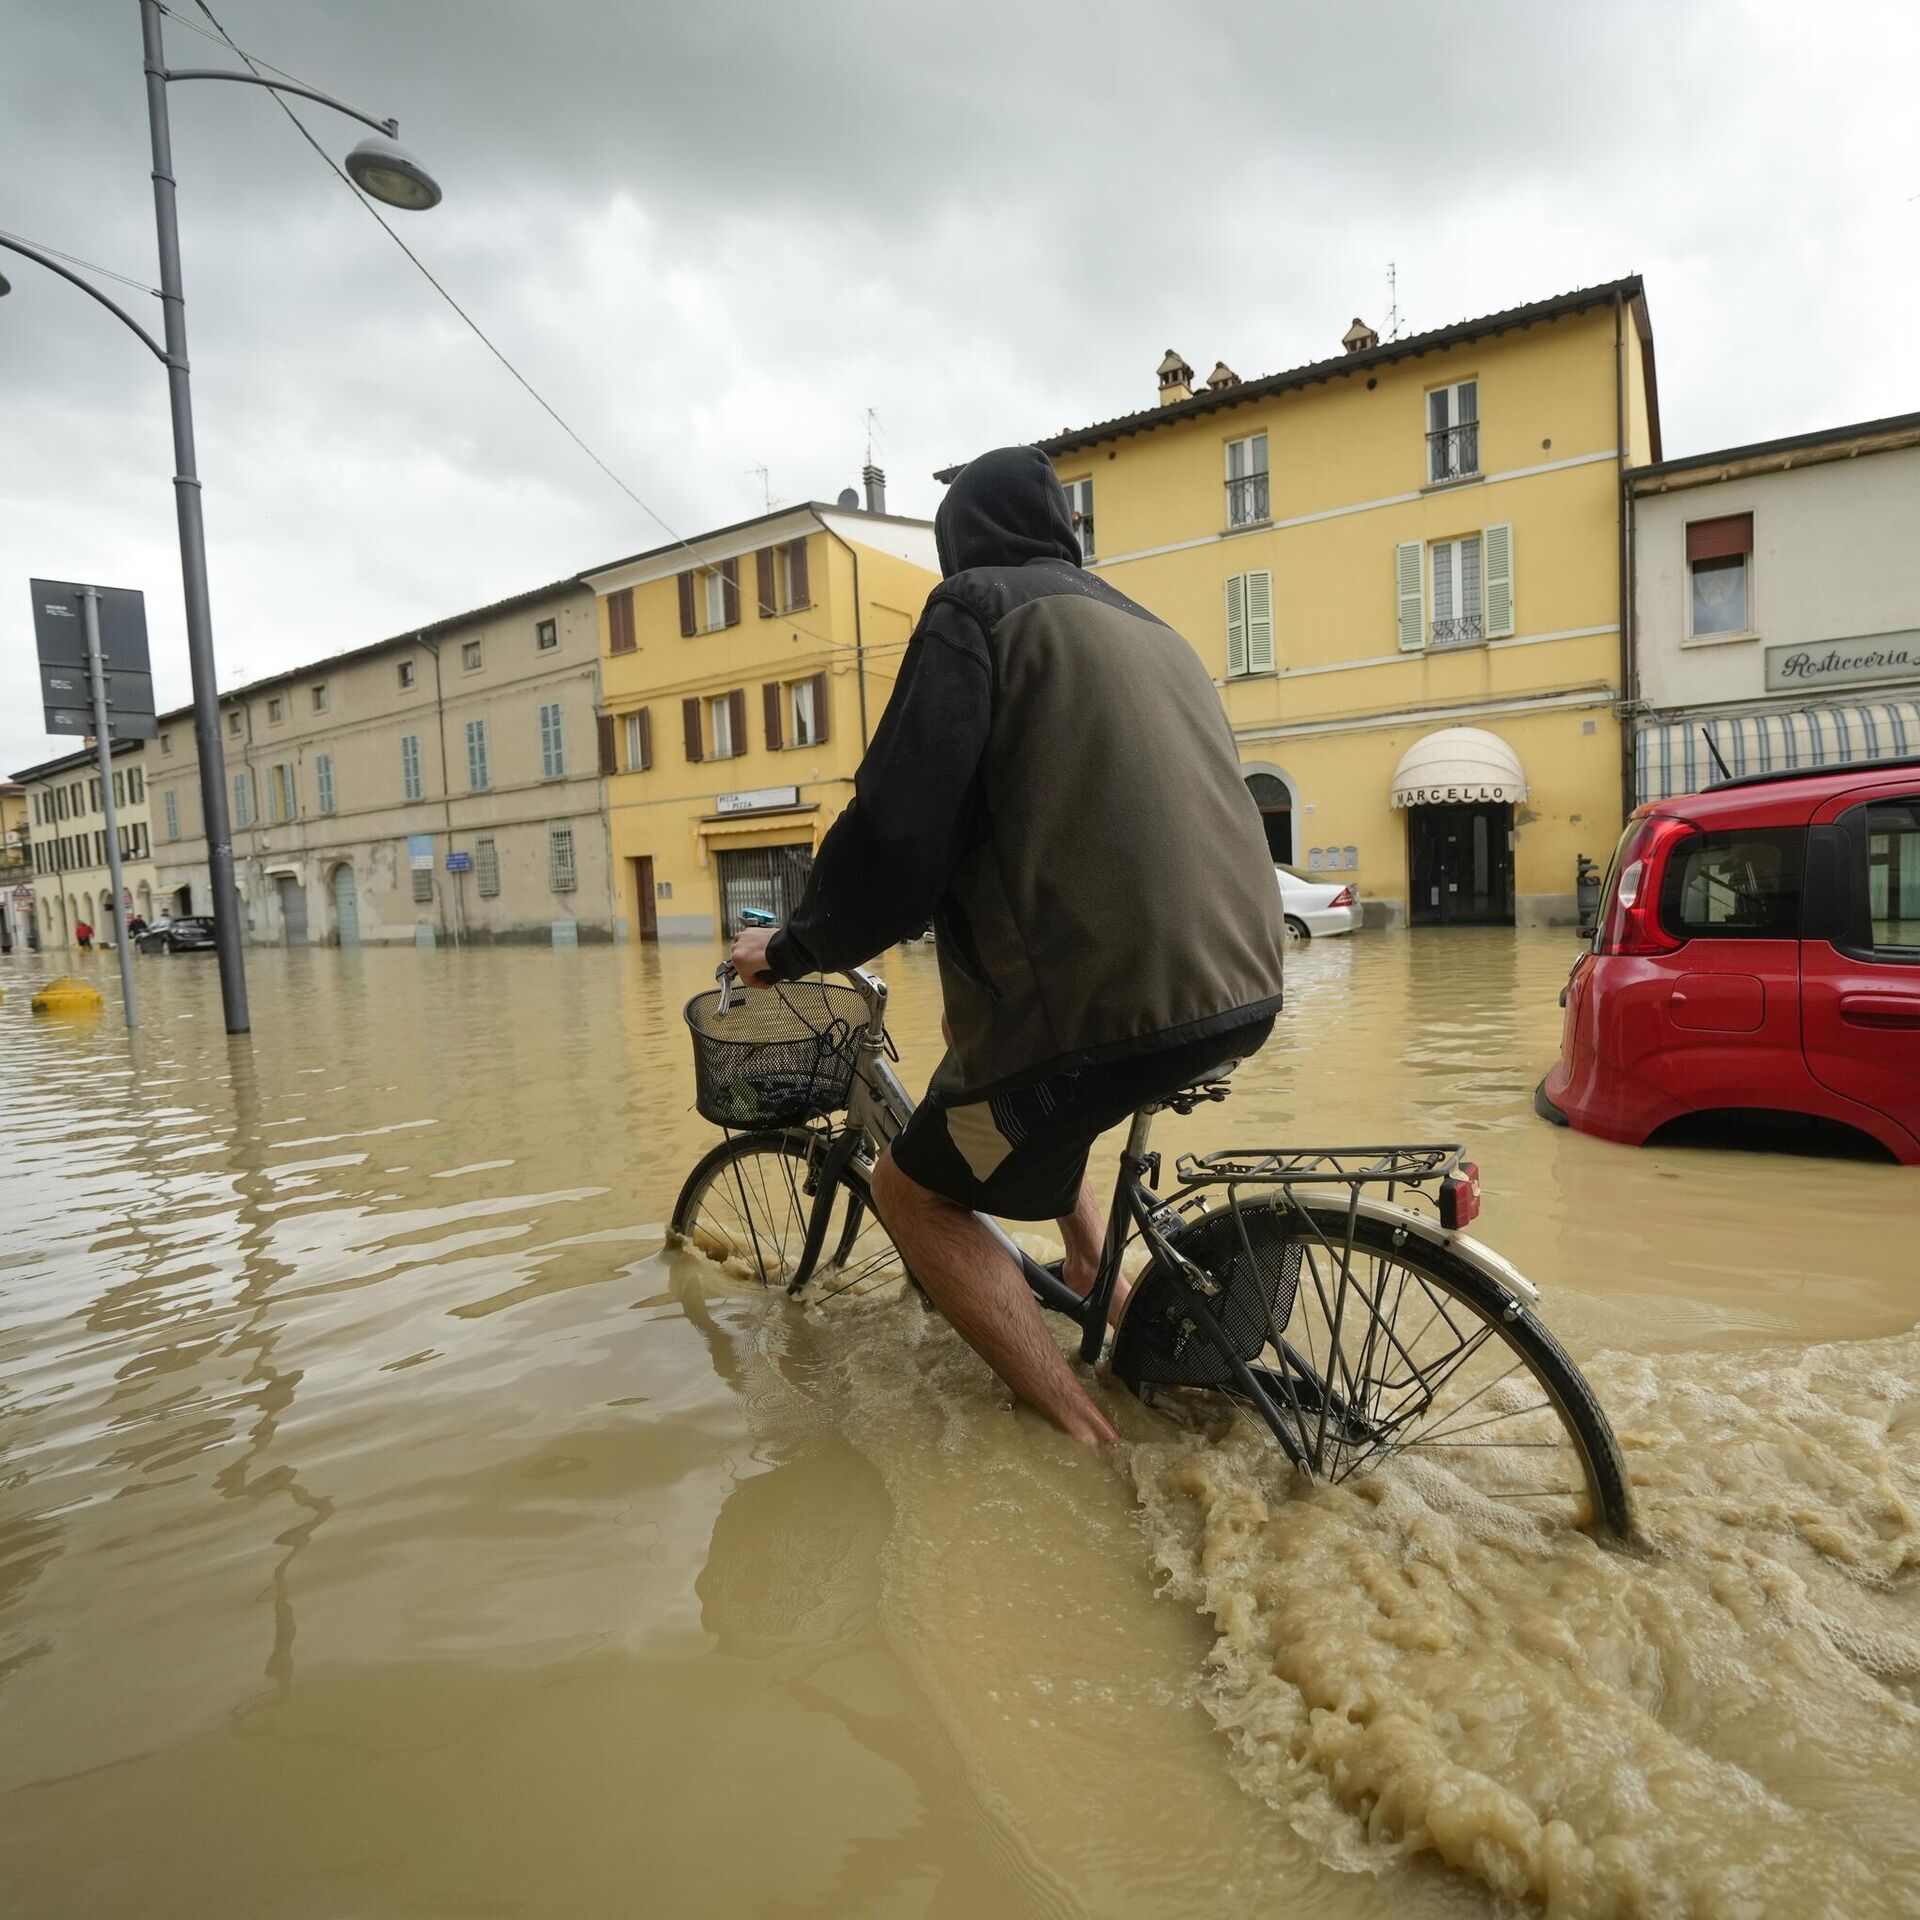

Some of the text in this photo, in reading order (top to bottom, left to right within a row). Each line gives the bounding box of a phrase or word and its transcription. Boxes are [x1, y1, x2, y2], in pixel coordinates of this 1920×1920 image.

[1781, 650, 1909, 678] Rosticceria
[719, 795, 739, 804] PIZZA
[1397, 787, 1503, 804] MARCELLO
[732, 801, 753, 809] PIZZA
